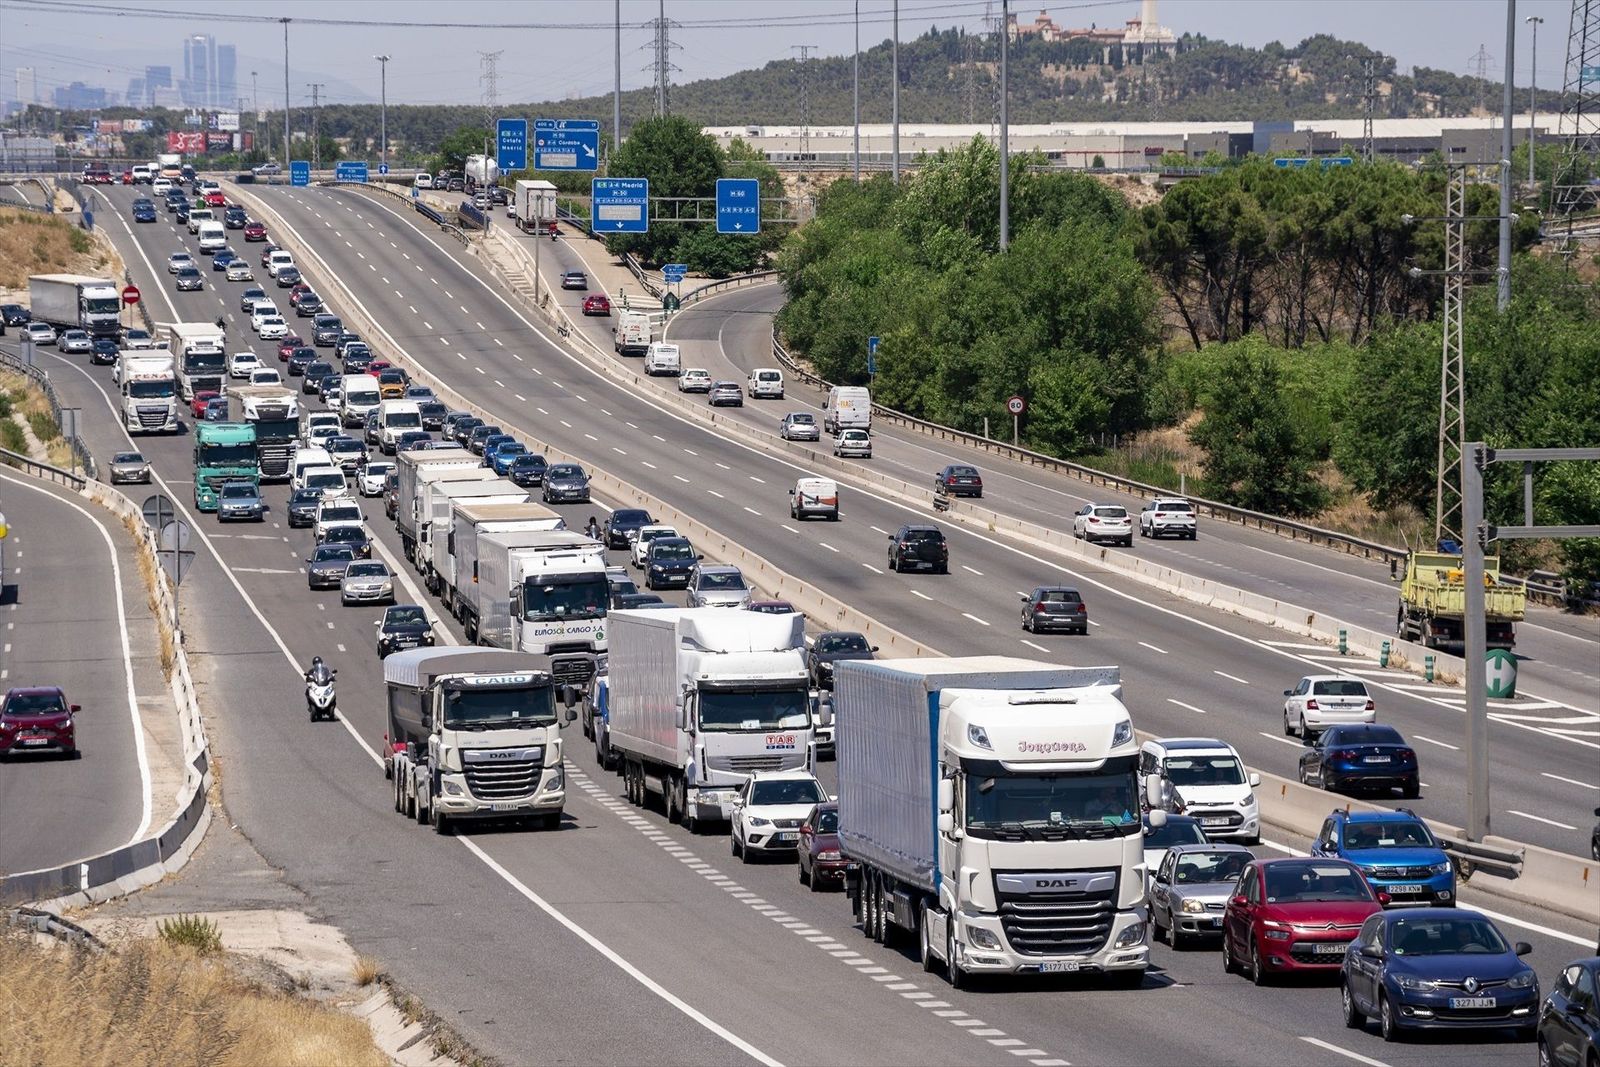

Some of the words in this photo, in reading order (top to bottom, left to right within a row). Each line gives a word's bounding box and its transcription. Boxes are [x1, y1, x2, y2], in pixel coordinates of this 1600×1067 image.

[534, 628, 565, 636] EUROSOL
[566, 626, 592, 634] CARGO
[475, 676, 526, 685] CARO
[767, 736, 795, 744] TAR
[1035, 879, 1078, 888] DAF
[1044, 963, 1061, 971] 5177
[1063, 962, 1078, 970] LCC
[1455, 999, 1476, 1007] 3271
[1478, 998, 1494, 1007] JJW
